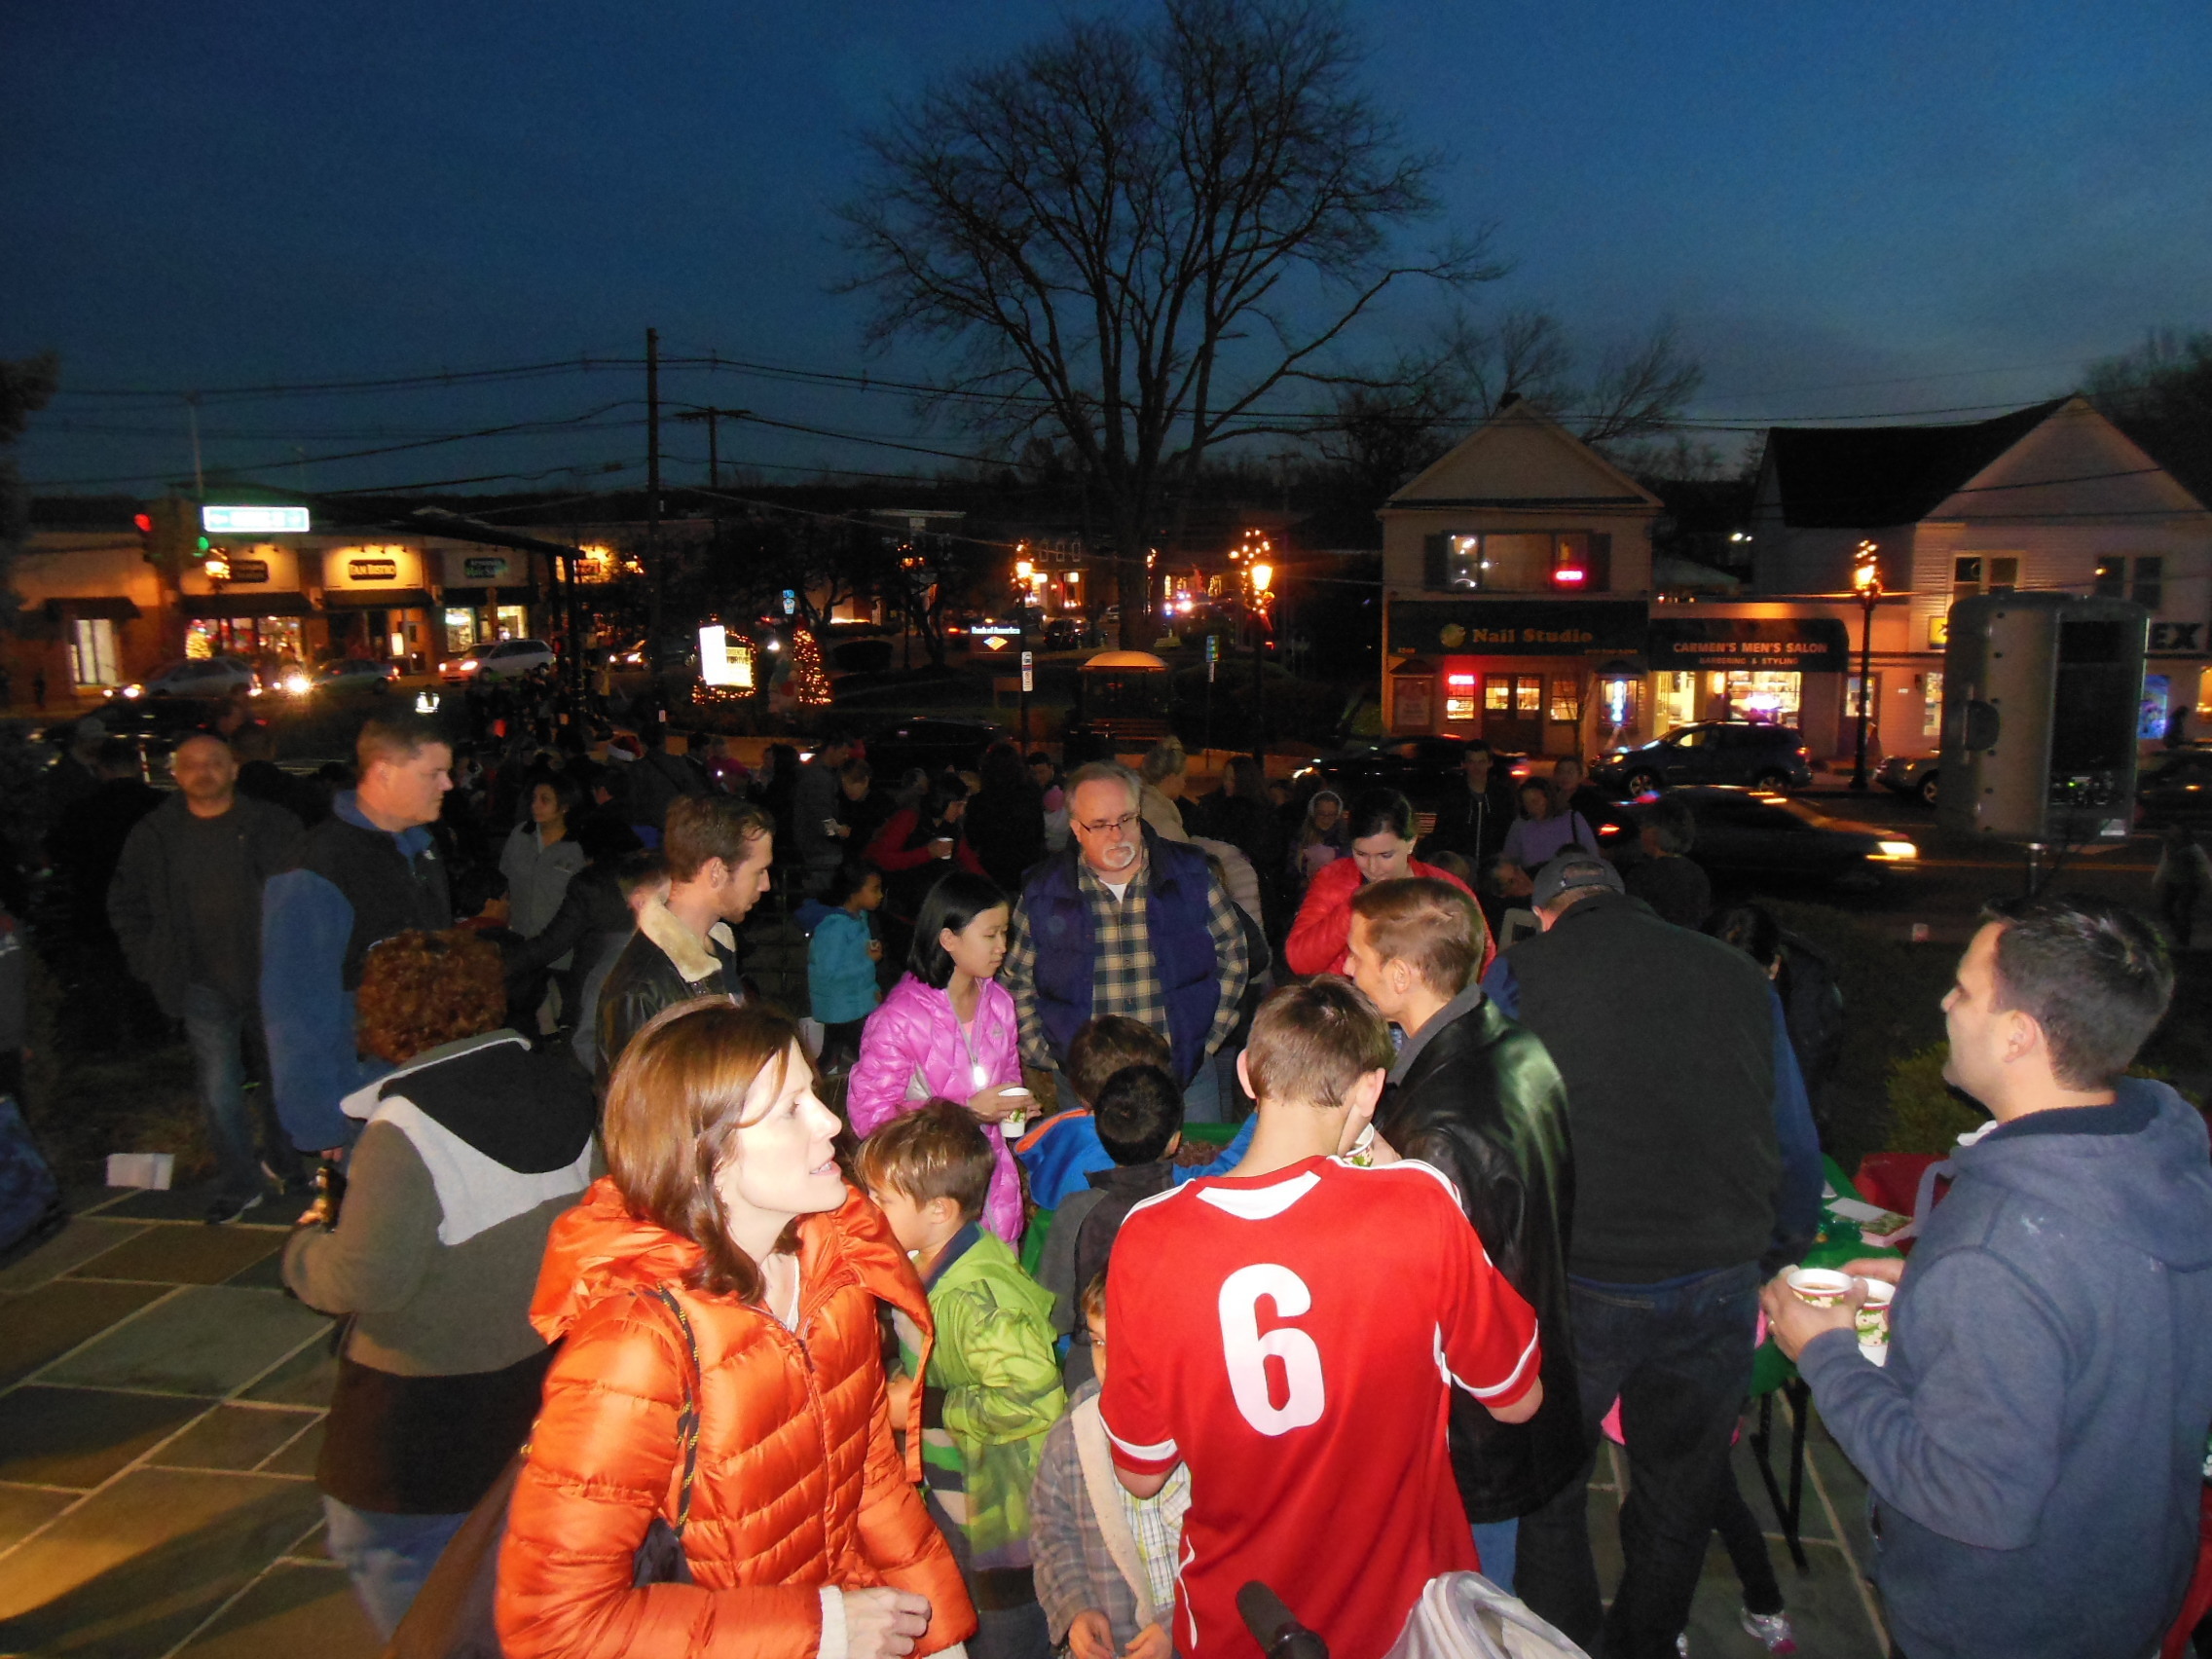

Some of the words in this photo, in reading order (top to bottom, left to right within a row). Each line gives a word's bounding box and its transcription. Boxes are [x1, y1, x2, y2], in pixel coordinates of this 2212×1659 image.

[1472, 628, 1515, 643] Nail
[1524, 628, 1593, 643] Studio
[1673, 642, 1737, 653] CARMEN'S
[1742, 643, 1782, 653] MEN'S
[1786, 643, 1827, 653] SALON
[1218, 1263, 1325, 1436] 6
